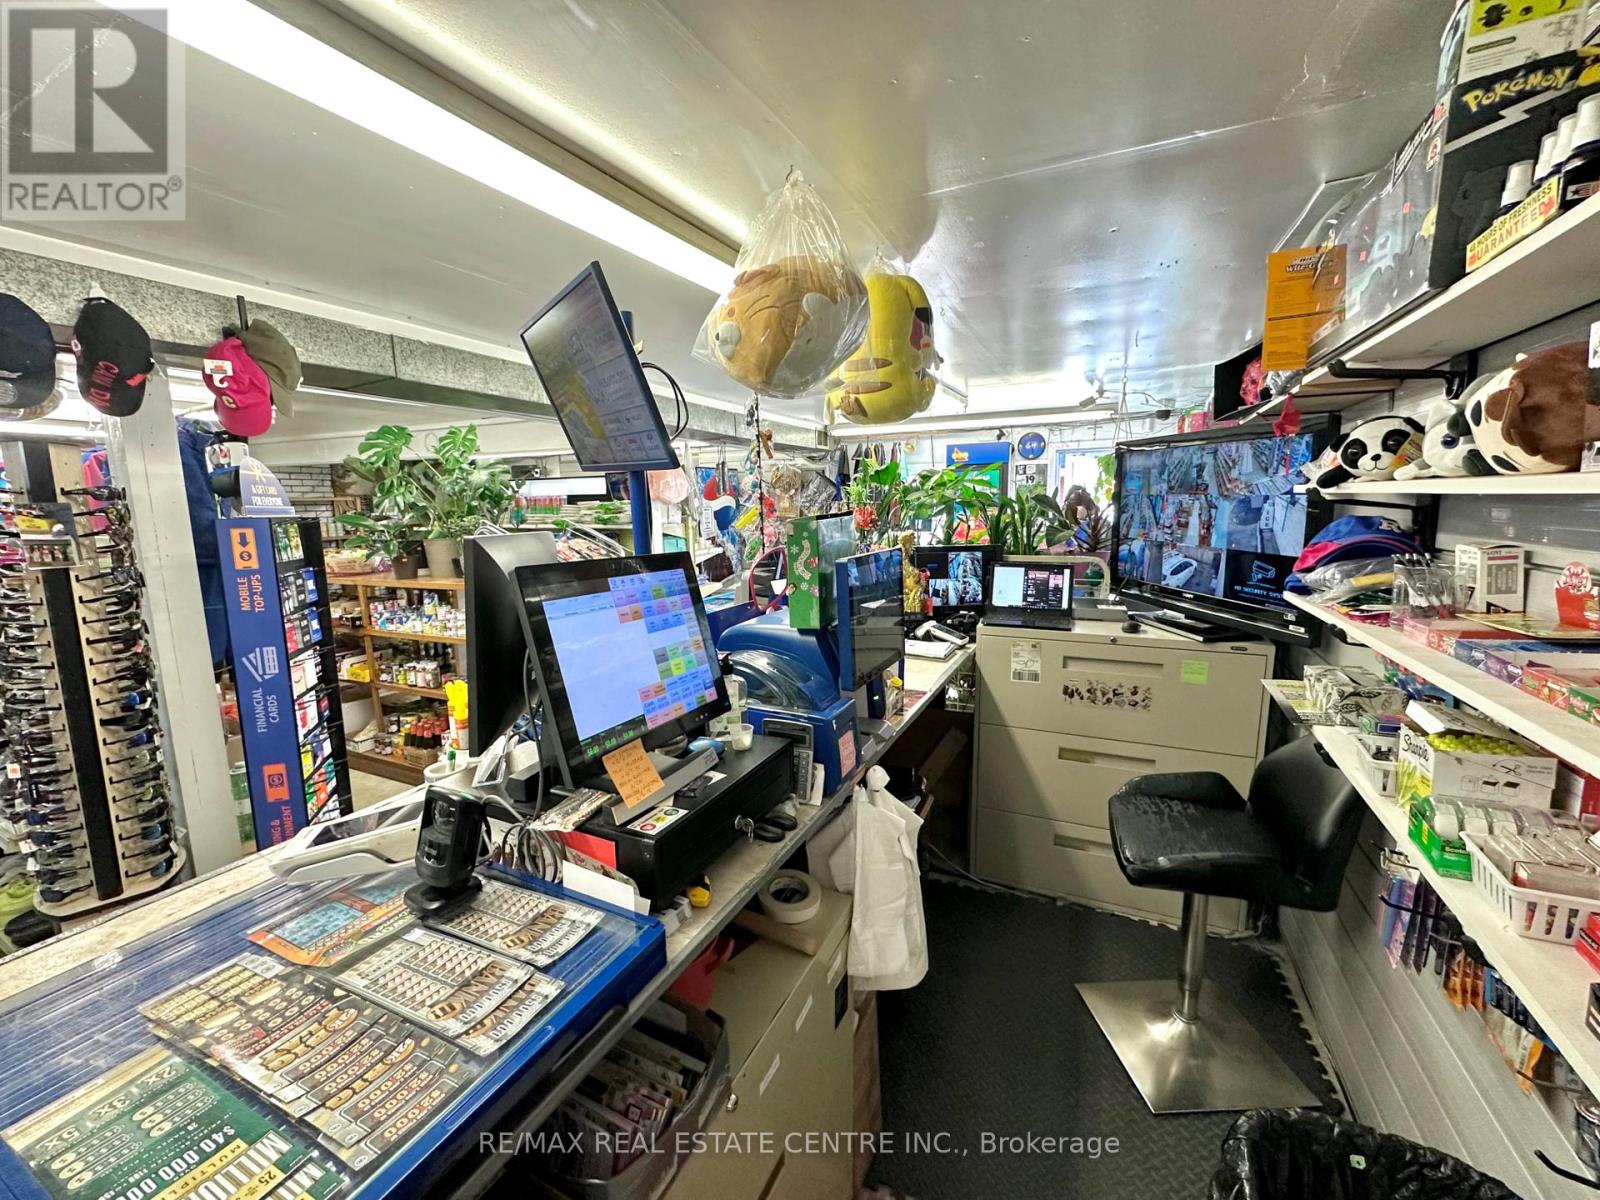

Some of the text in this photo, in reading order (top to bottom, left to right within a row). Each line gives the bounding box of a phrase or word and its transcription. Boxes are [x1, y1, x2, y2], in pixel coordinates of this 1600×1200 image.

[1507, 182, 1553, 224] FRESHNESS
[240, 576, 252, 612] MOBILE
[254, 574, 265, 613] TOP-UPS
[257, 686, 269, 733] FINANCIAL
[268, 694, 279, 723] CARDS
[448, 958, 508, 1007] BANK
[257, 1169, 277, 1188] 25
